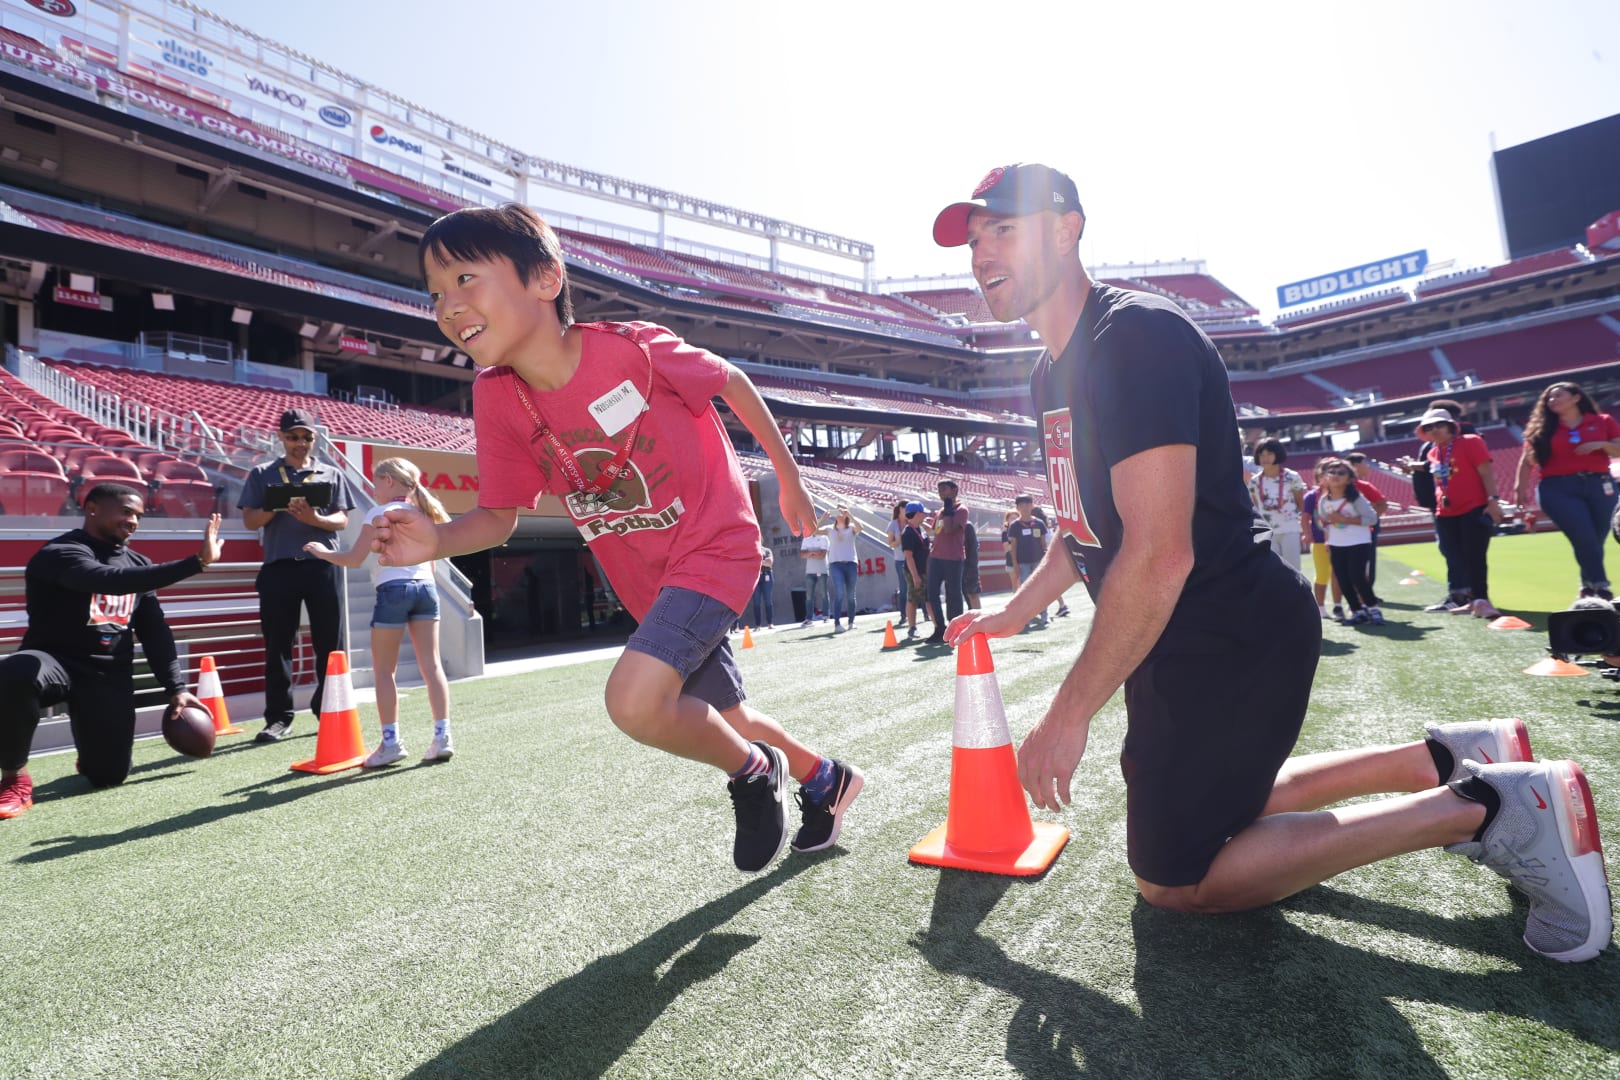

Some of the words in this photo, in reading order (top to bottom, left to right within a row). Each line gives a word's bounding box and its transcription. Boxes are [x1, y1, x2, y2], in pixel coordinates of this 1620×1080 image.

[0, 41, 97, 85] UPER
[107, 80, 195, 121] BOWL
[203, 111, 348, 175] CHAMPIONS
[245, 73, 307, 110] YAHOO!
[388, 136, 423, 155] pepsi
